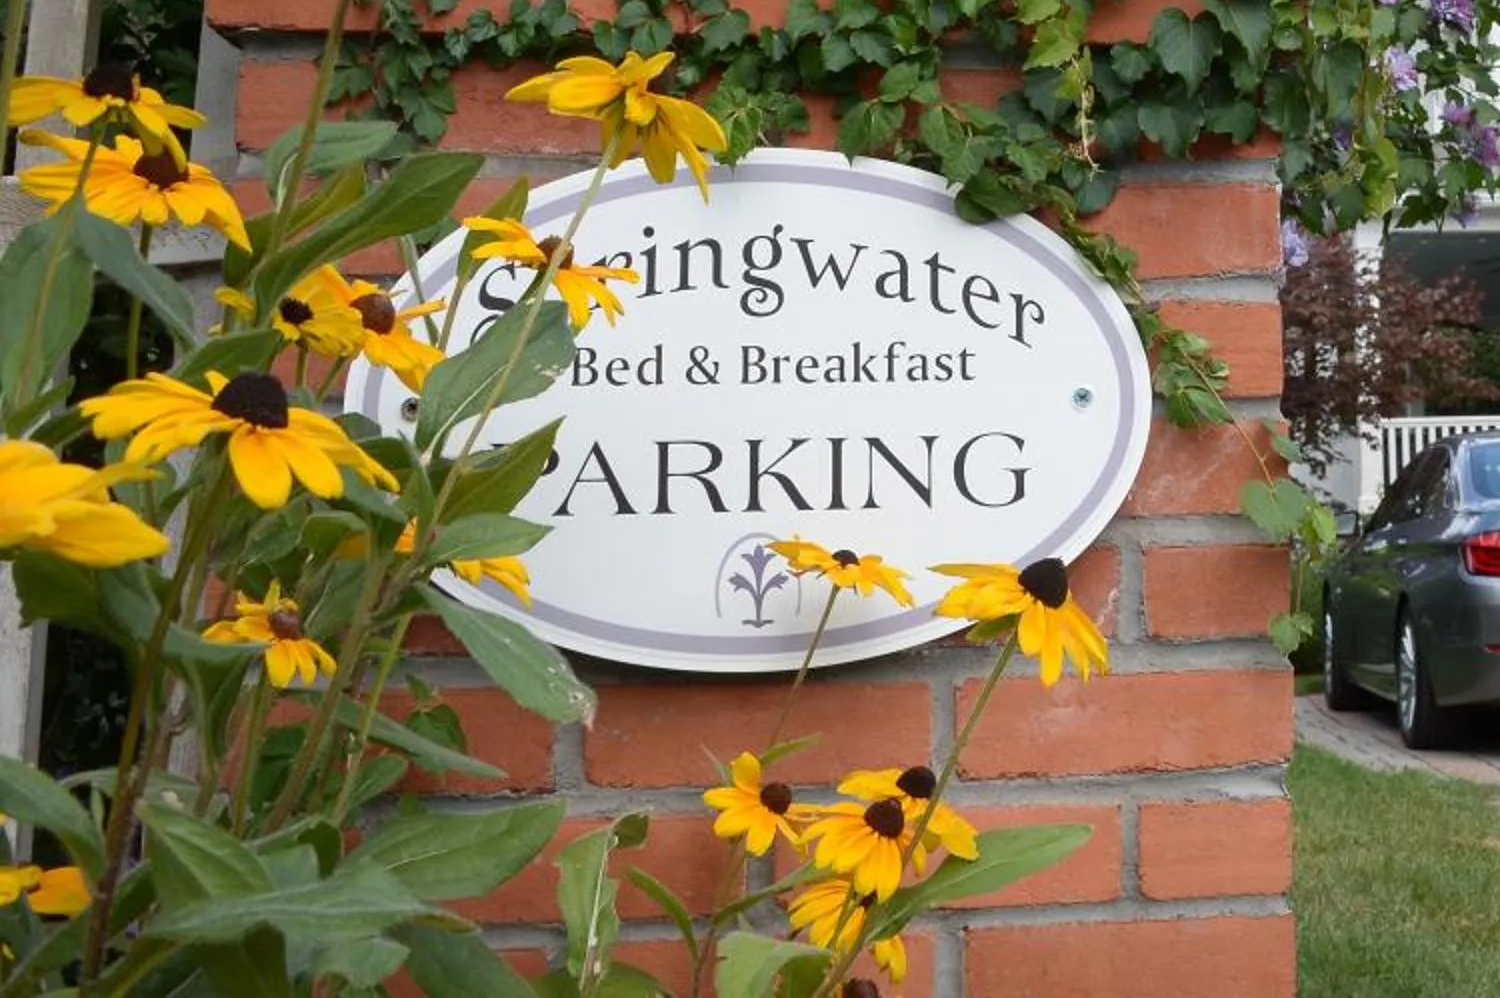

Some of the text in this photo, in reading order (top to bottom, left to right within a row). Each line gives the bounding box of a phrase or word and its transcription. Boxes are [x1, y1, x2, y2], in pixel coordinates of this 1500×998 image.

[470, 224, 1045, 348] Sringwater
[571, 341, 977, 387] Bed & Breakfast
[490, 432, 1034, 516] ARKING
